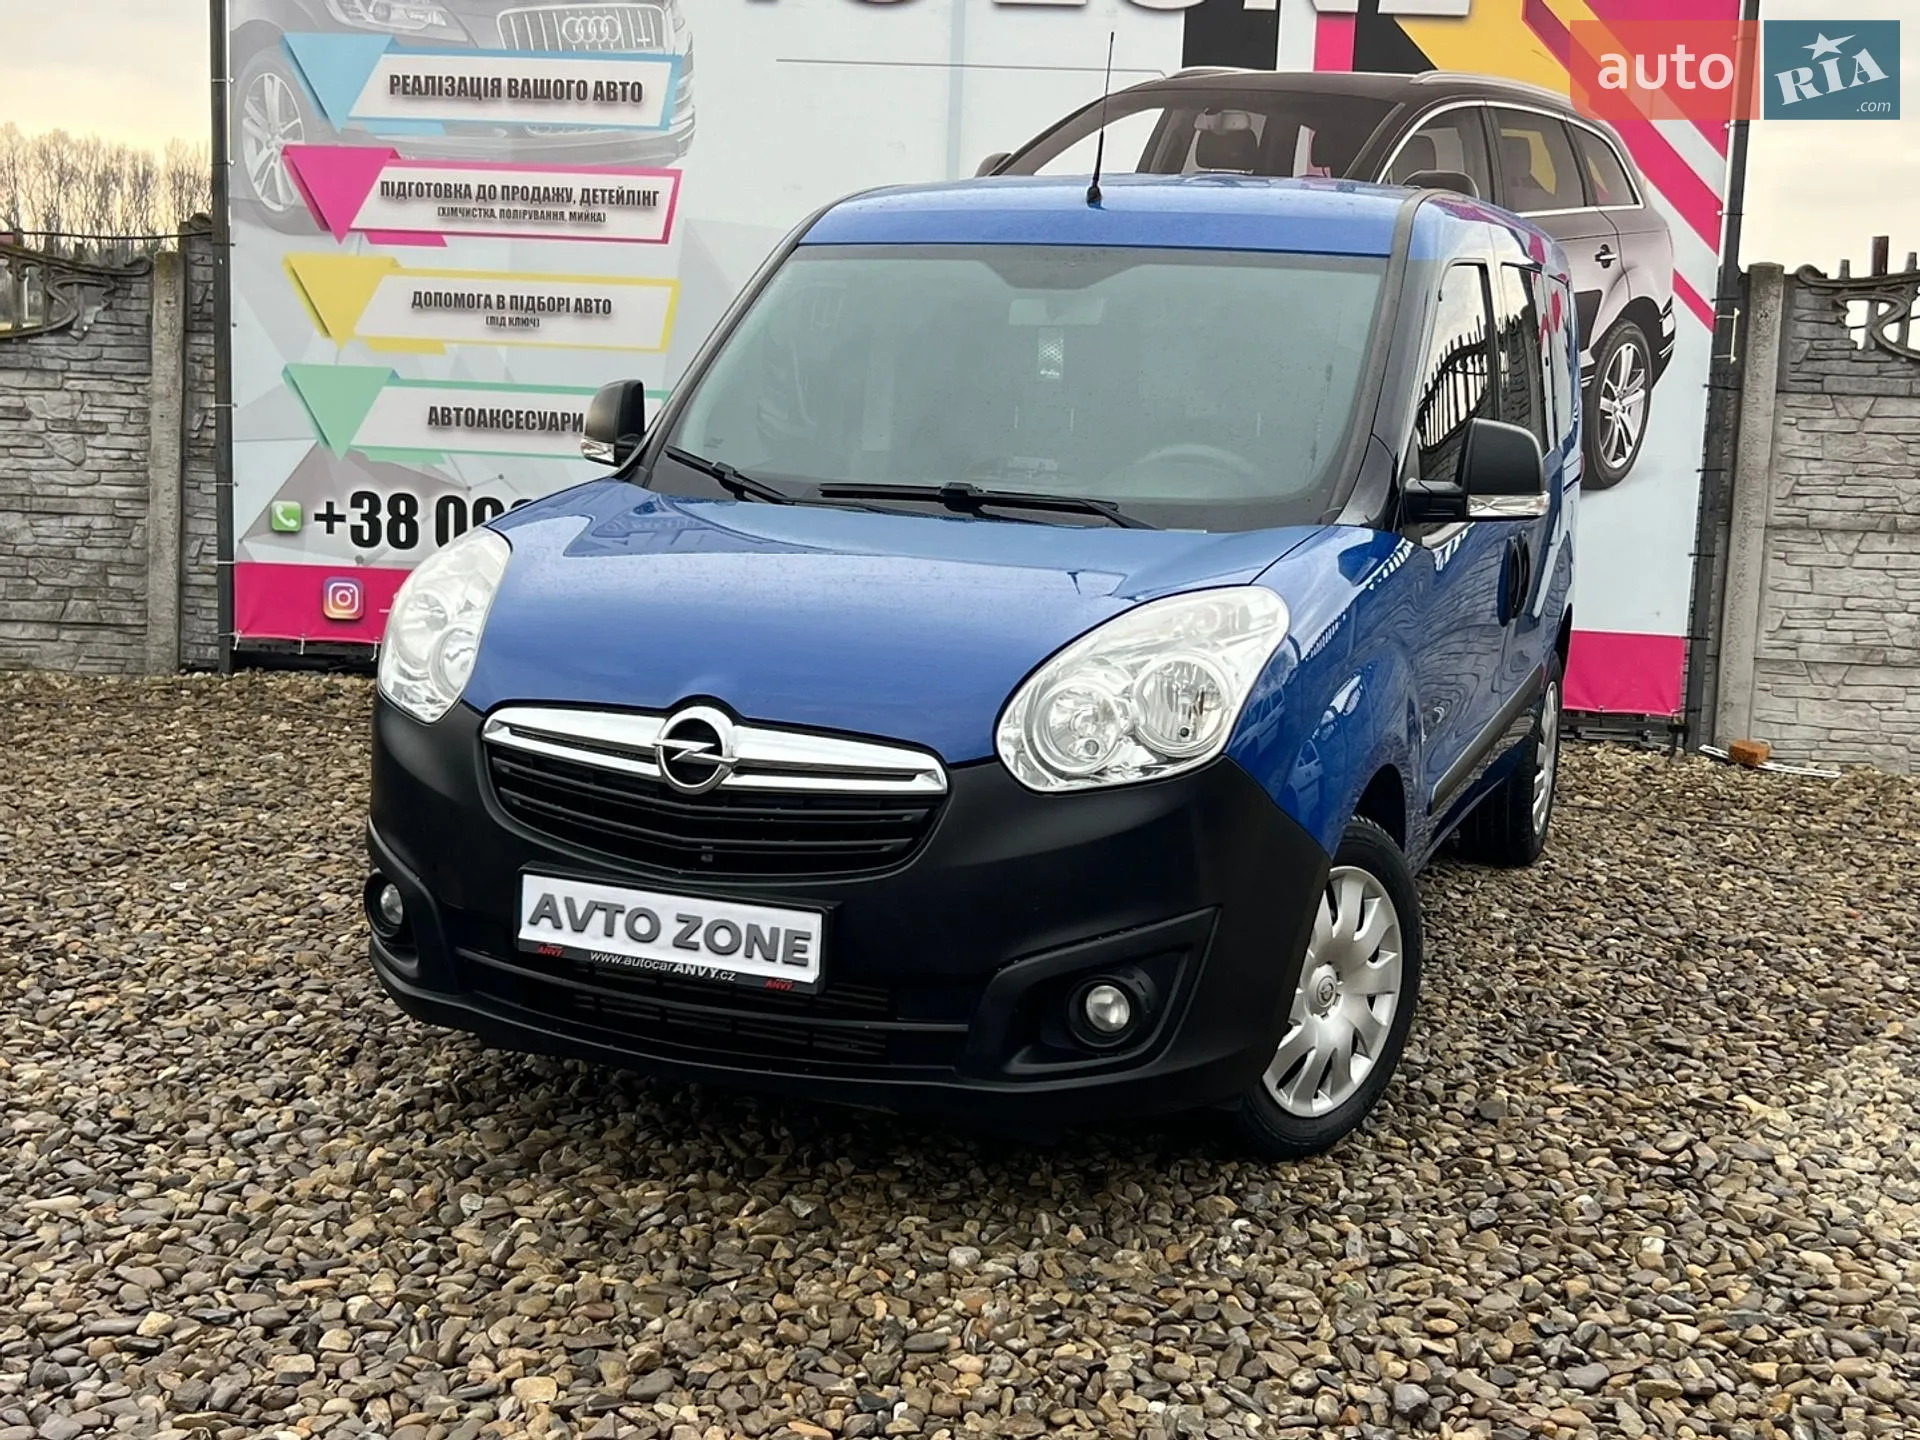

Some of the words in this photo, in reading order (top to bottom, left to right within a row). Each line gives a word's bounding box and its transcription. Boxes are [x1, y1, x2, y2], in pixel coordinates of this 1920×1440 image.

[389, 74, 502, 101] РЕАЛІЗАЦІЯ
[507, 77, 588, 101] ВАШОГО
[593, 80, 643, 103] АВТО
[380, 180, 472, 200] ПІДГОТОВКА
[475, 183, 497, 202] ДО
[501, 185, 576, 205] ПРОДАЖУ,
[580, 186, 659, 207] ДЕТЕЙЛІНГ
[411, 291, 493, 309] ДОПОМОГА
[496, 294, 505, 310] В
[509, 295, 570, 314] ПІДБОРІ
[573, 297, 612, 315] АВТО
[428, 406, 584, 433] АВТОАКСЕСУАРИ
[314, 490, 419, 550] +38
[528, 892, 661, 943] AVTO
[672, 912, 812, 967] ZONE
[590, 951, 736, 982] www.autocarANVY.cz
